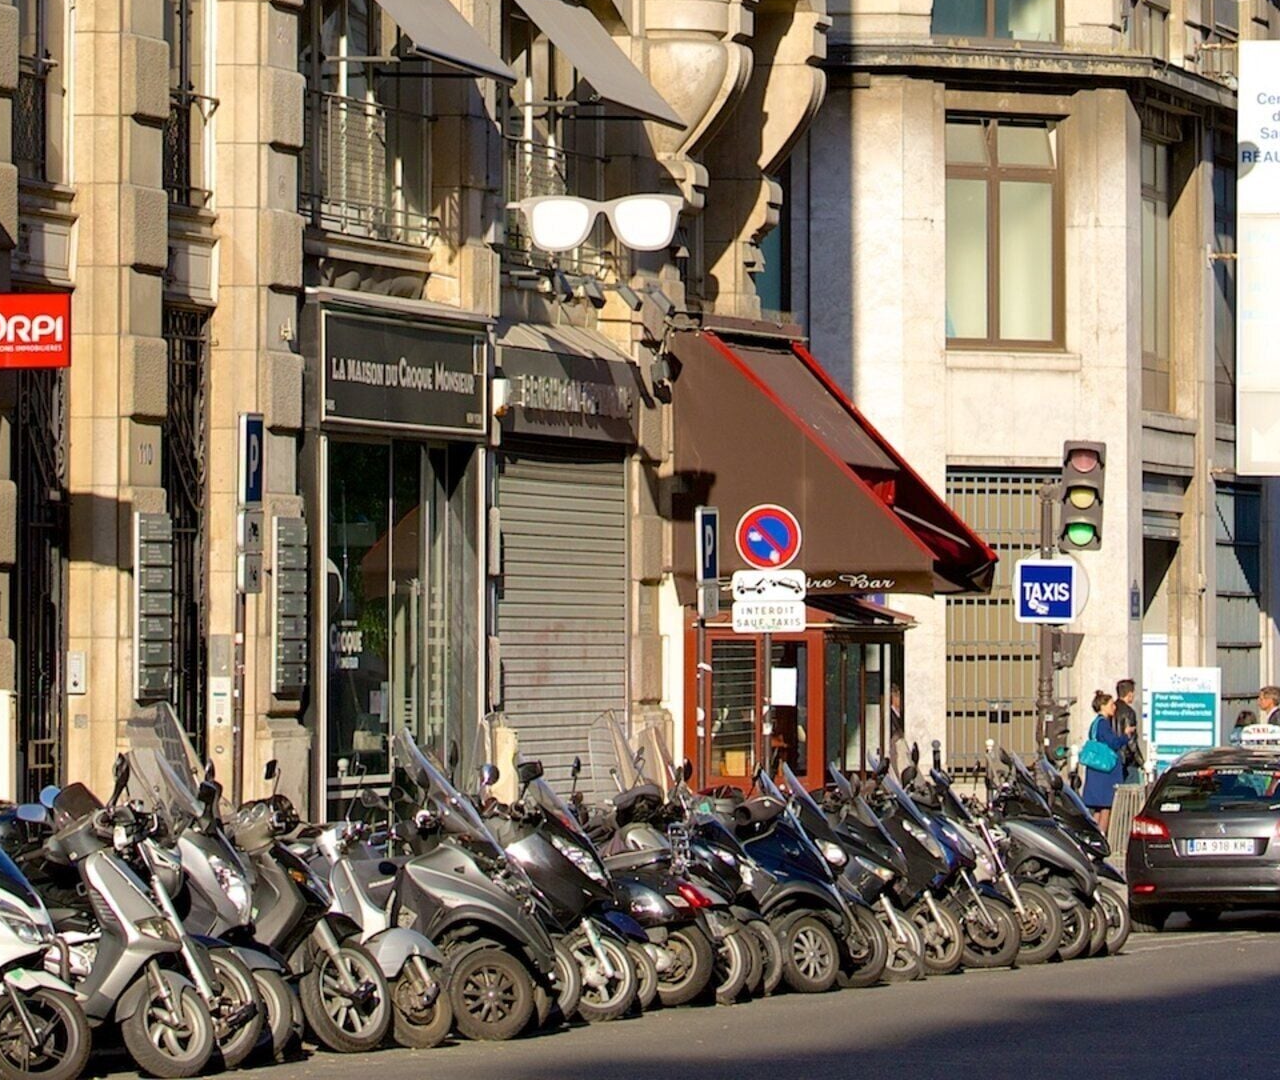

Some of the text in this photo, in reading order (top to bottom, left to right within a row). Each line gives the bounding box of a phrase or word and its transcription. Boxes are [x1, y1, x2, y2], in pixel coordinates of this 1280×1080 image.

[332, 357, 475, 395] LA MAISON DU CROQUE MONSIEUR
[139, 442, 154, 465] 110
[838, 574, 896, 589] Bar
[1022, 582, 1070, 602] TAXIS
[741, 606, 795, 616] INTERDIT
[737, 617, 802, 628] SAUF TAXIS
